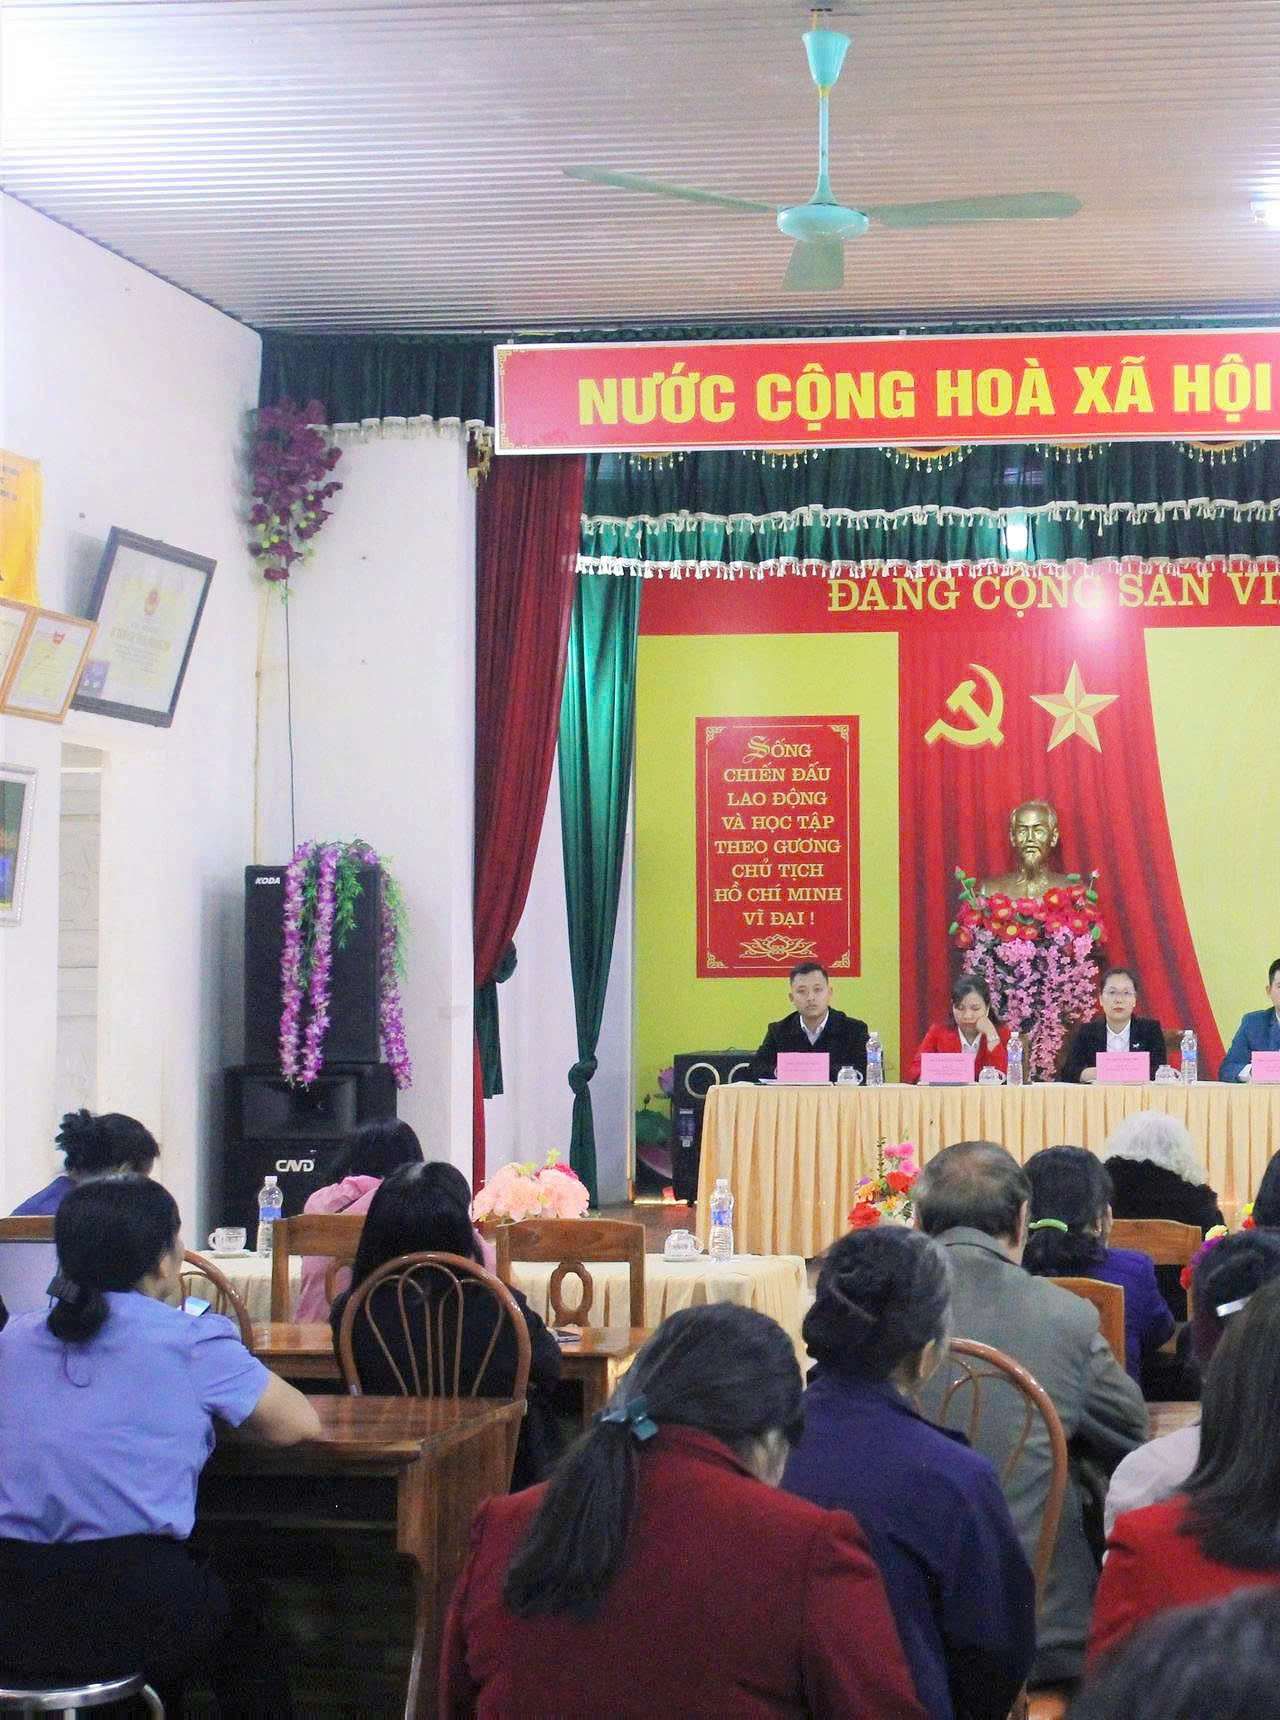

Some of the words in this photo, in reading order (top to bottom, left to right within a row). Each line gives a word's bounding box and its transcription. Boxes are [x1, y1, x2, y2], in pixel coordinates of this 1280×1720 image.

[578, 362, 735, 425] NƯỚC
[757, 363, 915, 431] CỘNG
[936, 357, 1055, 417] HOÀ
[1073, 355, 1153, 414] XÃ
[1173, 353, 1271, 423] HỘI
[723, 762, 786, 782] CHIẾN
[792, 761, 831, 781] ĐẤU
[728, 792, 766, 806] LAO
[773, 787, 828, 808] ĐỘNG
[721, 812, 745, 830] VÀ
[752, 815, 791, 833] HỌC
[797, 811, 834, 832] TẬP
[714, 840, 768, 854] THEO
[774, 838, 841, 854] GƯƠNG
[732, 857, 772, 878] CHỦ
[778, 863, 824, 881] TỊCH
[255, 876, 281, 885] KODA
[714, 880, 742, 902] HỒ
[748, 884, 781, 902] CHÍ
[788, 887, 842, 902] MINH
[742, 908, 764, 926] VĨ
[770, 911, 804, 929] ĐẠI
